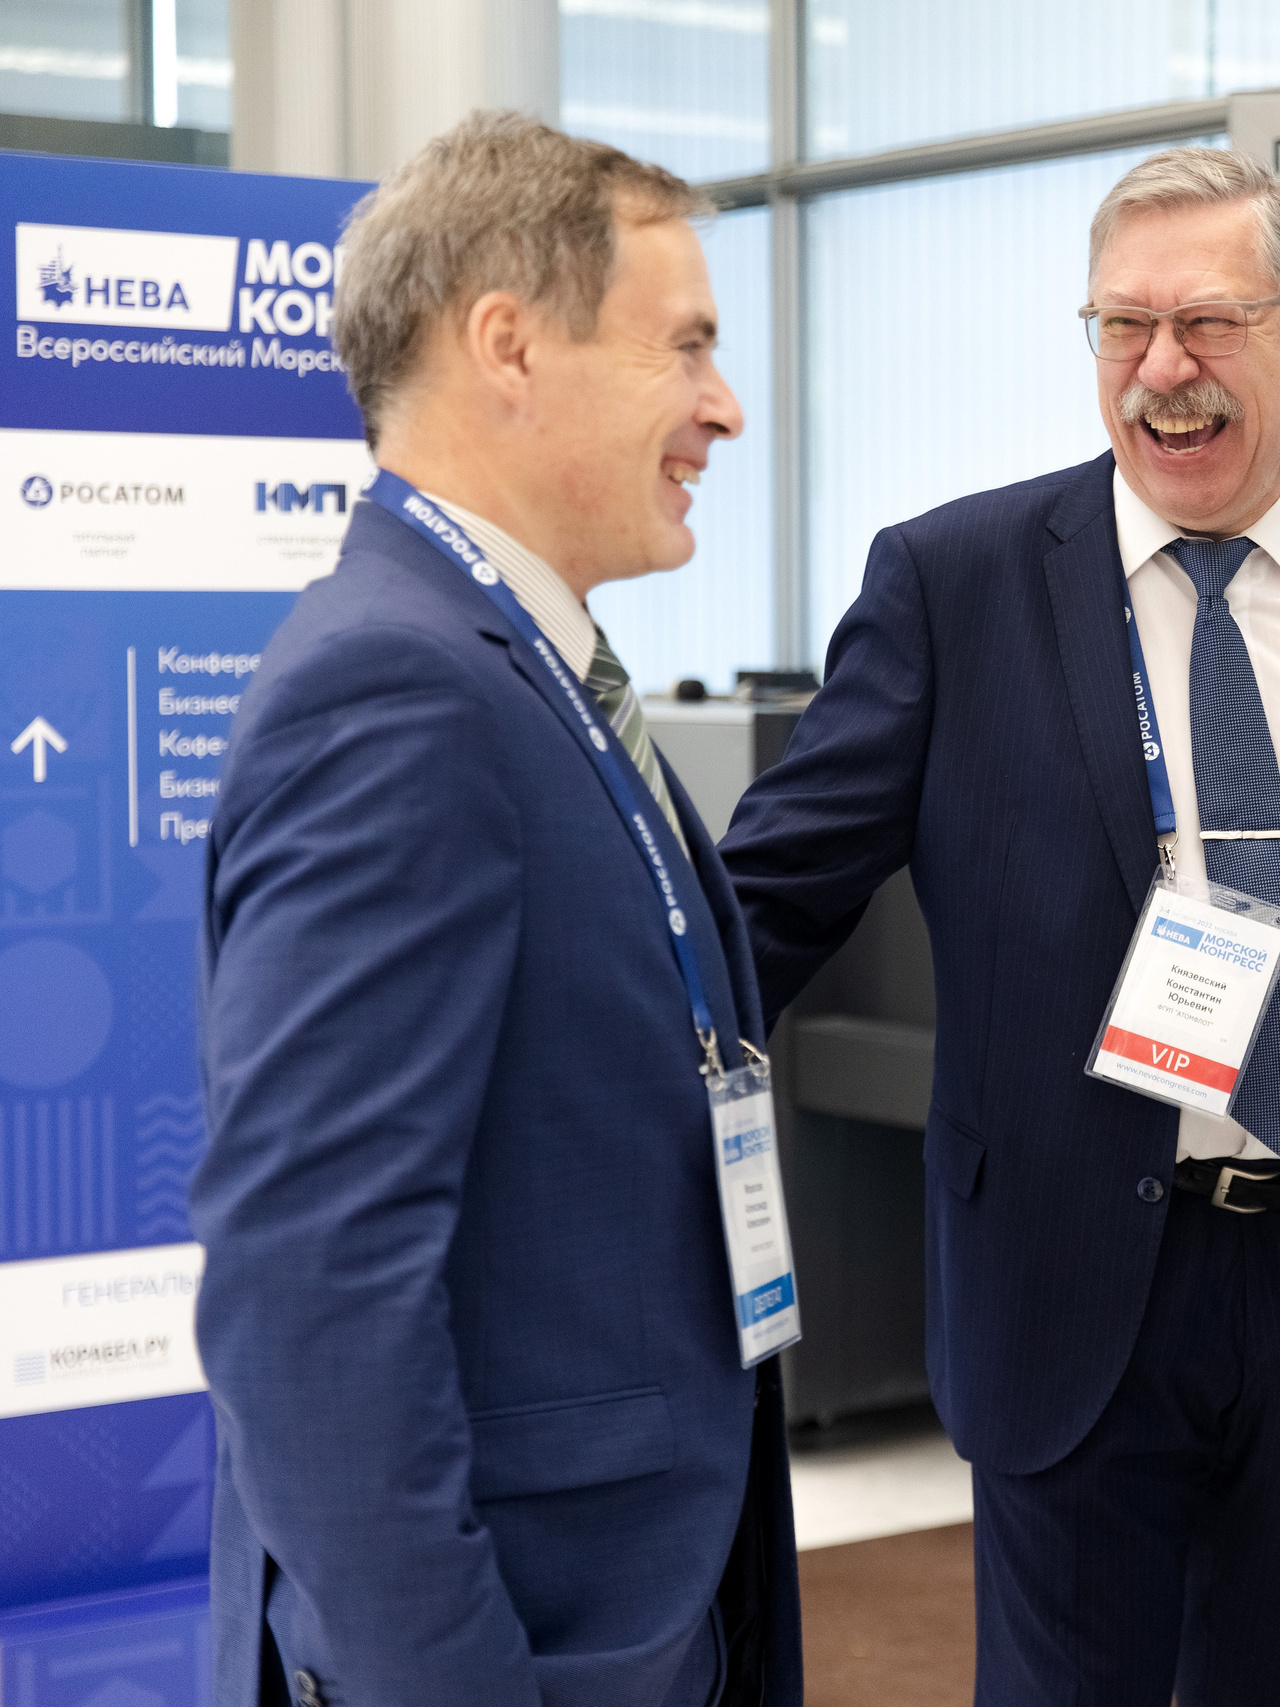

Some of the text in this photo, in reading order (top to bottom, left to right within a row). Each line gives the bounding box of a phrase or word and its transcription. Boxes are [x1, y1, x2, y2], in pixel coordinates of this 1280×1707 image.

[84, 277, 190, 312] НЕВА
[16, 325, 245, 367] Всероссийский
[60, 481, 184, 506] РОСАТОМ
[403, 496, 478, 563] РОСАТОМ
[160, 769, 220, 798] Бизн
[160, 811, 213, 846] Пре
[1166, 929, 1191, 945] НЕВА
[1197, 919, 1213, 929] 2022
[1199, 943, 1264, 973] КОНГРЕСС
[1204, 933, 1268, 963] МОРСКОЙ
[1166, 978, 1222, 1005] Константин
[1171, 964, 1227, 991] Князевский
[1168, 992, 1213, 1015] Юрьевич
[1151, 1044, 1190, 1072] VIP
[1116, 1062, 1208, 1098] www.nevacongress.com
